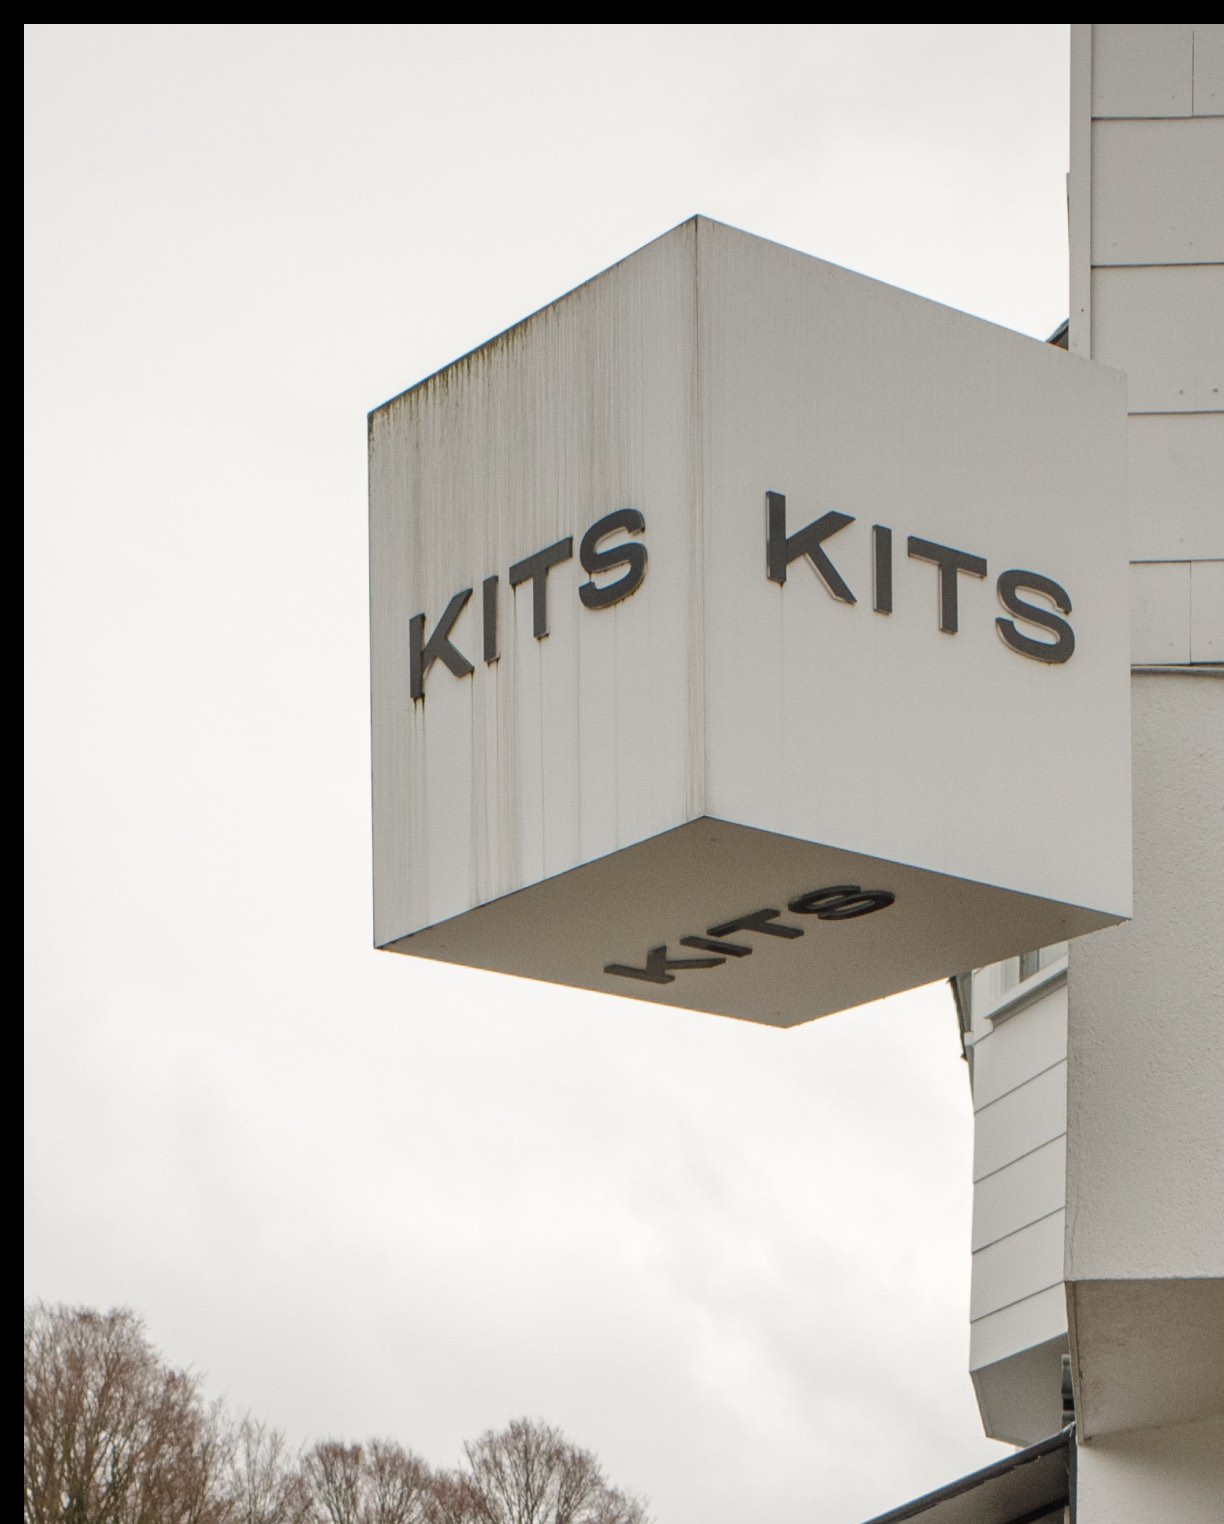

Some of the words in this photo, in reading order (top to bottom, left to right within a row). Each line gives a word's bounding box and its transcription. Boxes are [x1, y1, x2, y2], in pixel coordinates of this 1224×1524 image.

[409, 508, 648, 700] KITS
[766, 491, 1076, 664] KITS
[604, 885, 895, 985] KITS
